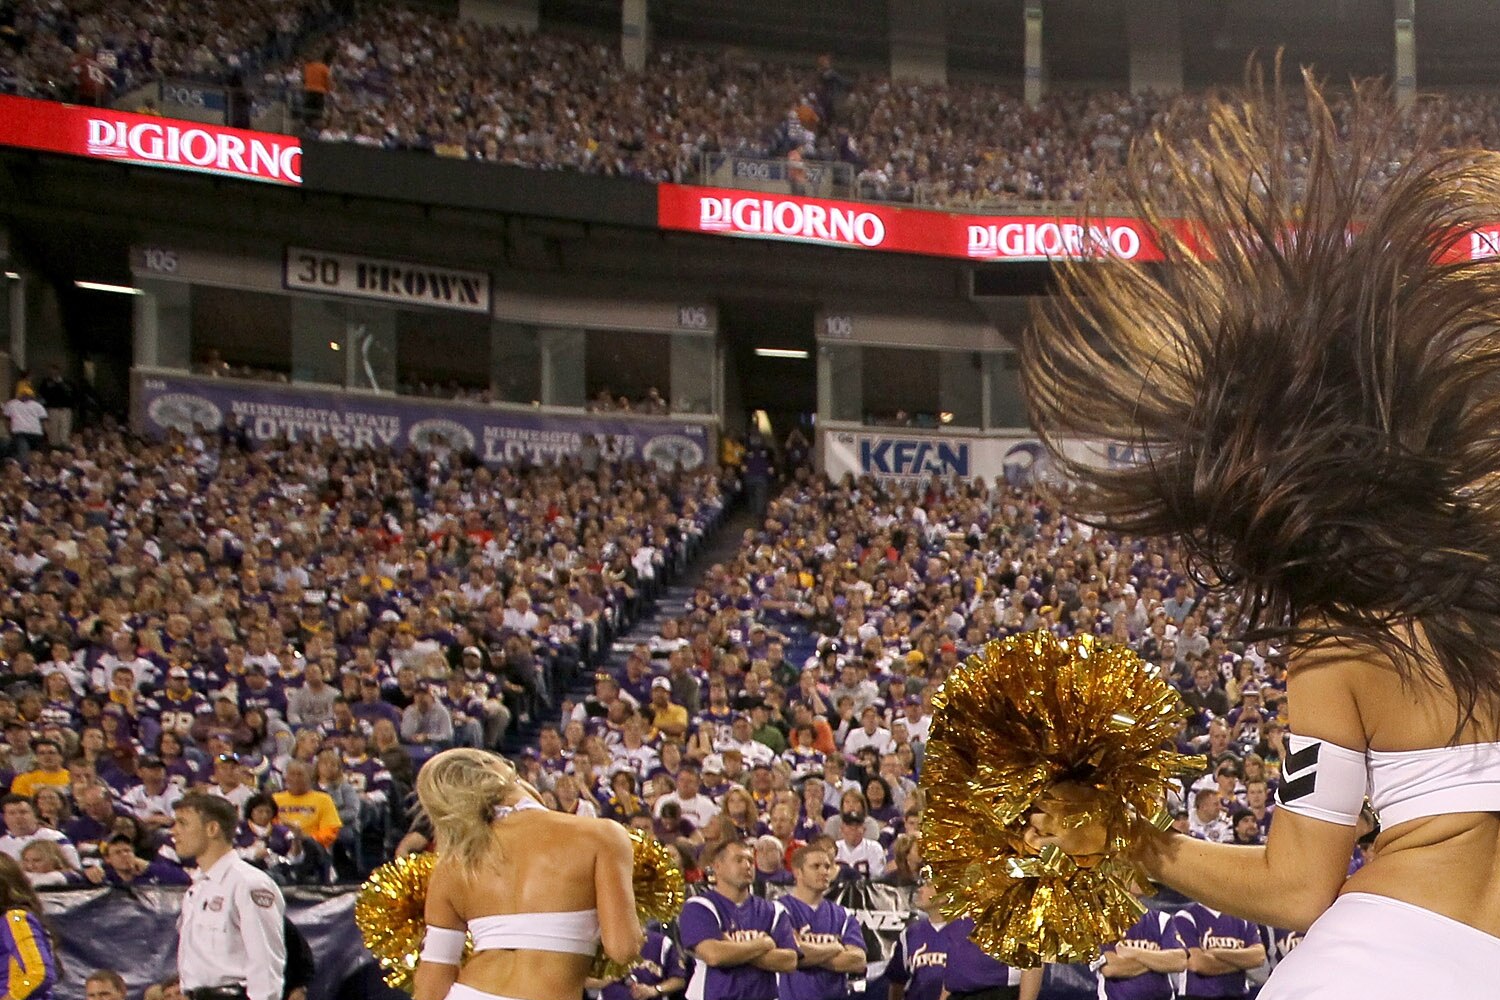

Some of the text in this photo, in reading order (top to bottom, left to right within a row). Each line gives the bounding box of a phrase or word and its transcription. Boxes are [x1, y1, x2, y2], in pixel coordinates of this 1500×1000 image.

[700, 197, 886, 247] DIGIORNO
[968, 223, 1140, 260] DIGIORNO
[298, 255, 481, 305] 30 BROWN
[231, 401, 400, 428] MINNESOTA STATE
[236, 415, 400, 449] OTTERY
[859, 438, 970, 477] KFAN
